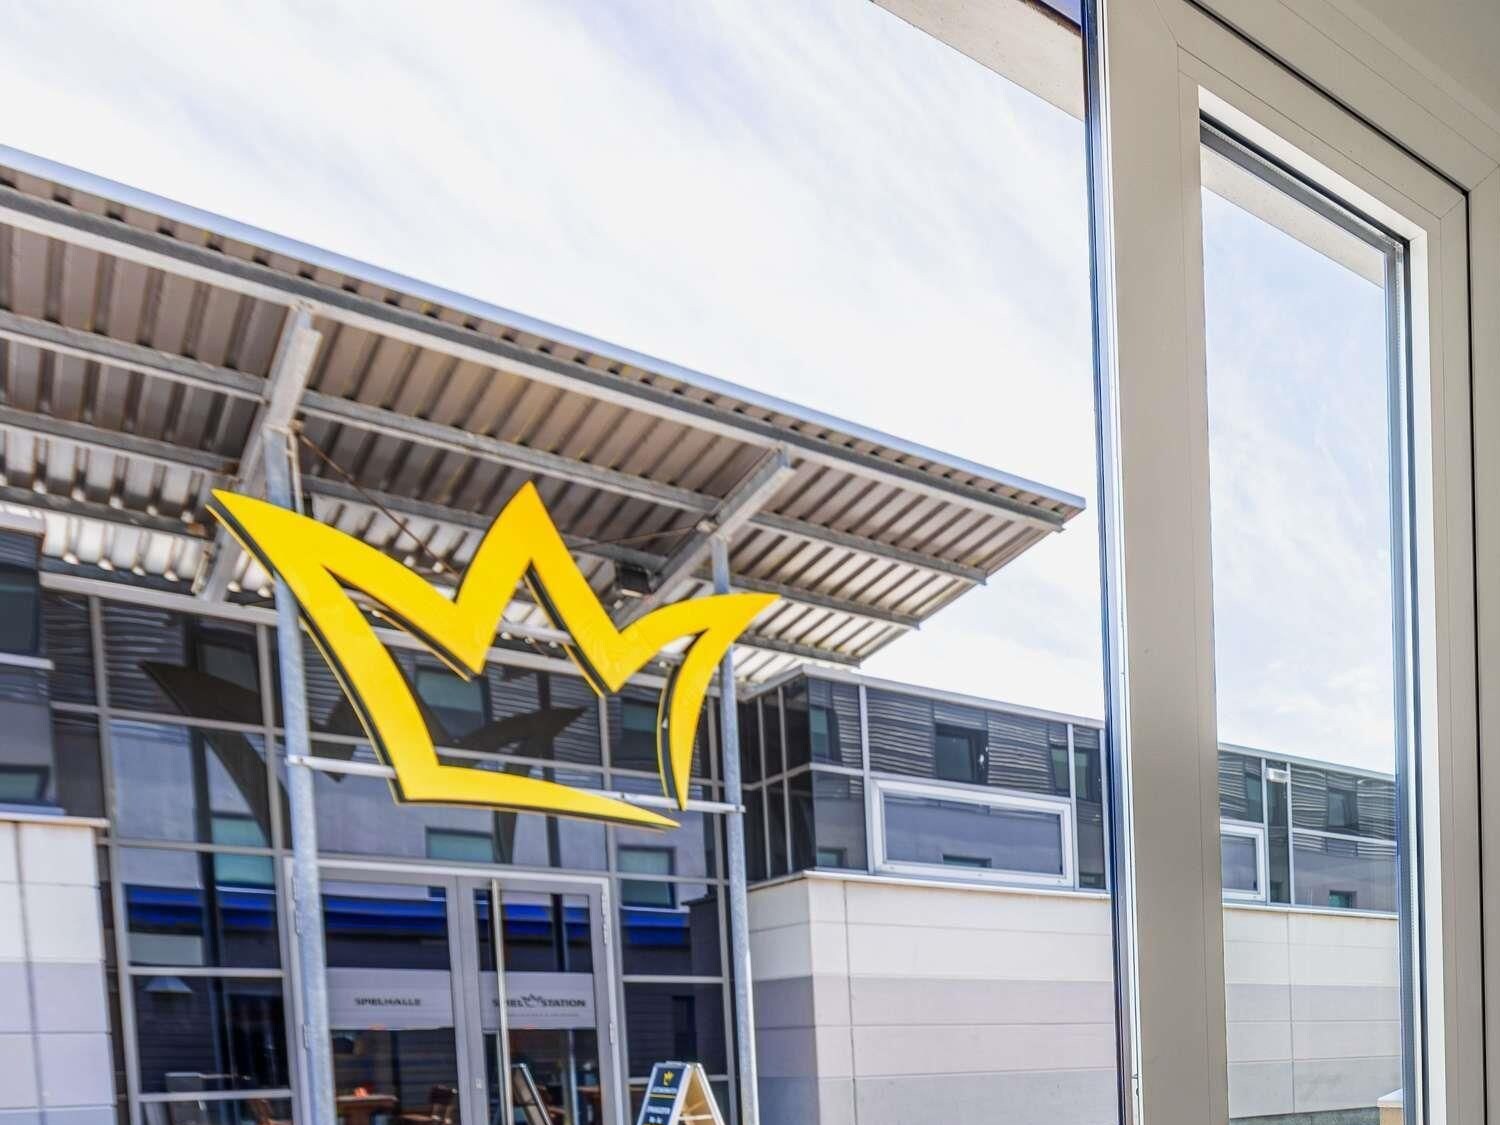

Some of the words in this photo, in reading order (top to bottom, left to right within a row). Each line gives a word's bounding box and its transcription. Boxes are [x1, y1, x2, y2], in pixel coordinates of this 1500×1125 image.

[354, 997, 421, 1006] SPIELHALLE
[492, 998, 523, 1008] SIEL
[543, 998, 586, 1008] STATION
